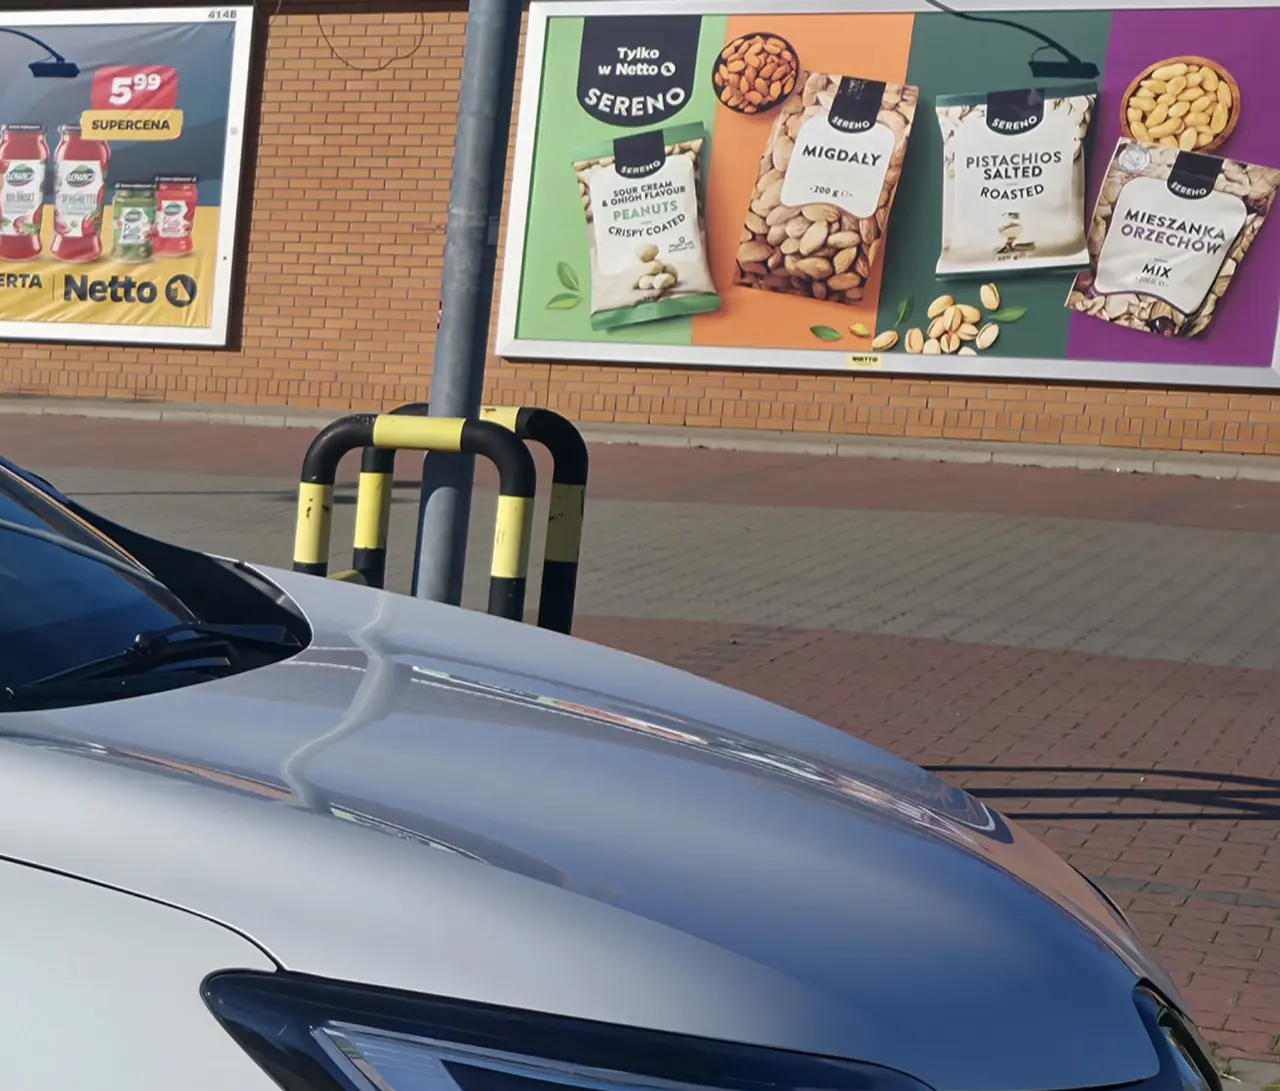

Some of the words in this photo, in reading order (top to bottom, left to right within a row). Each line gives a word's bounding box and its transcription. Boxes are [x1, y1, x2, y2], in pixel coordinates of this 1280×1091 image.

[617, 46, 660, 61] Tylko
[598, 64, 612, 75] w
[615, 62, 659, 76] Netto
[584, 87, 685, 116] SERENO
[92, 119, 171, 131] SUPERCENA
[831, 116, 870, 129] SERENO
[992, 115, 1038, 131] SERENO
[802, 144, 882, 167] MIGDAŁY
[965, 150, 1062, 169] PISTACHIOS
[620, 160, 662, 174] SERENO
[984, 165, 1043, 180] SALTED
[611, 194, 641, 206] ONION
[644, 185, 686, 200] FLAVOUR
[613, 186, 638, 198] SOUR
[641, 180, 672, 192] CREAM
[980, 184, 1045, 200] ROASTED
[1170, 181, 1207, 196] SERENO
[613, 200, 678, 221] PEANUTS
[608, 226, 644, 238] CRISPY
[646, 213, 686, 236] COATED
[1124, 208, 1226, 241] MIESZANKA
[1121, 224, 1221, 255] ORZECHÓW
[1142, 263, 1172, 279] MIX
[64, 274, 158, 303] Netto
